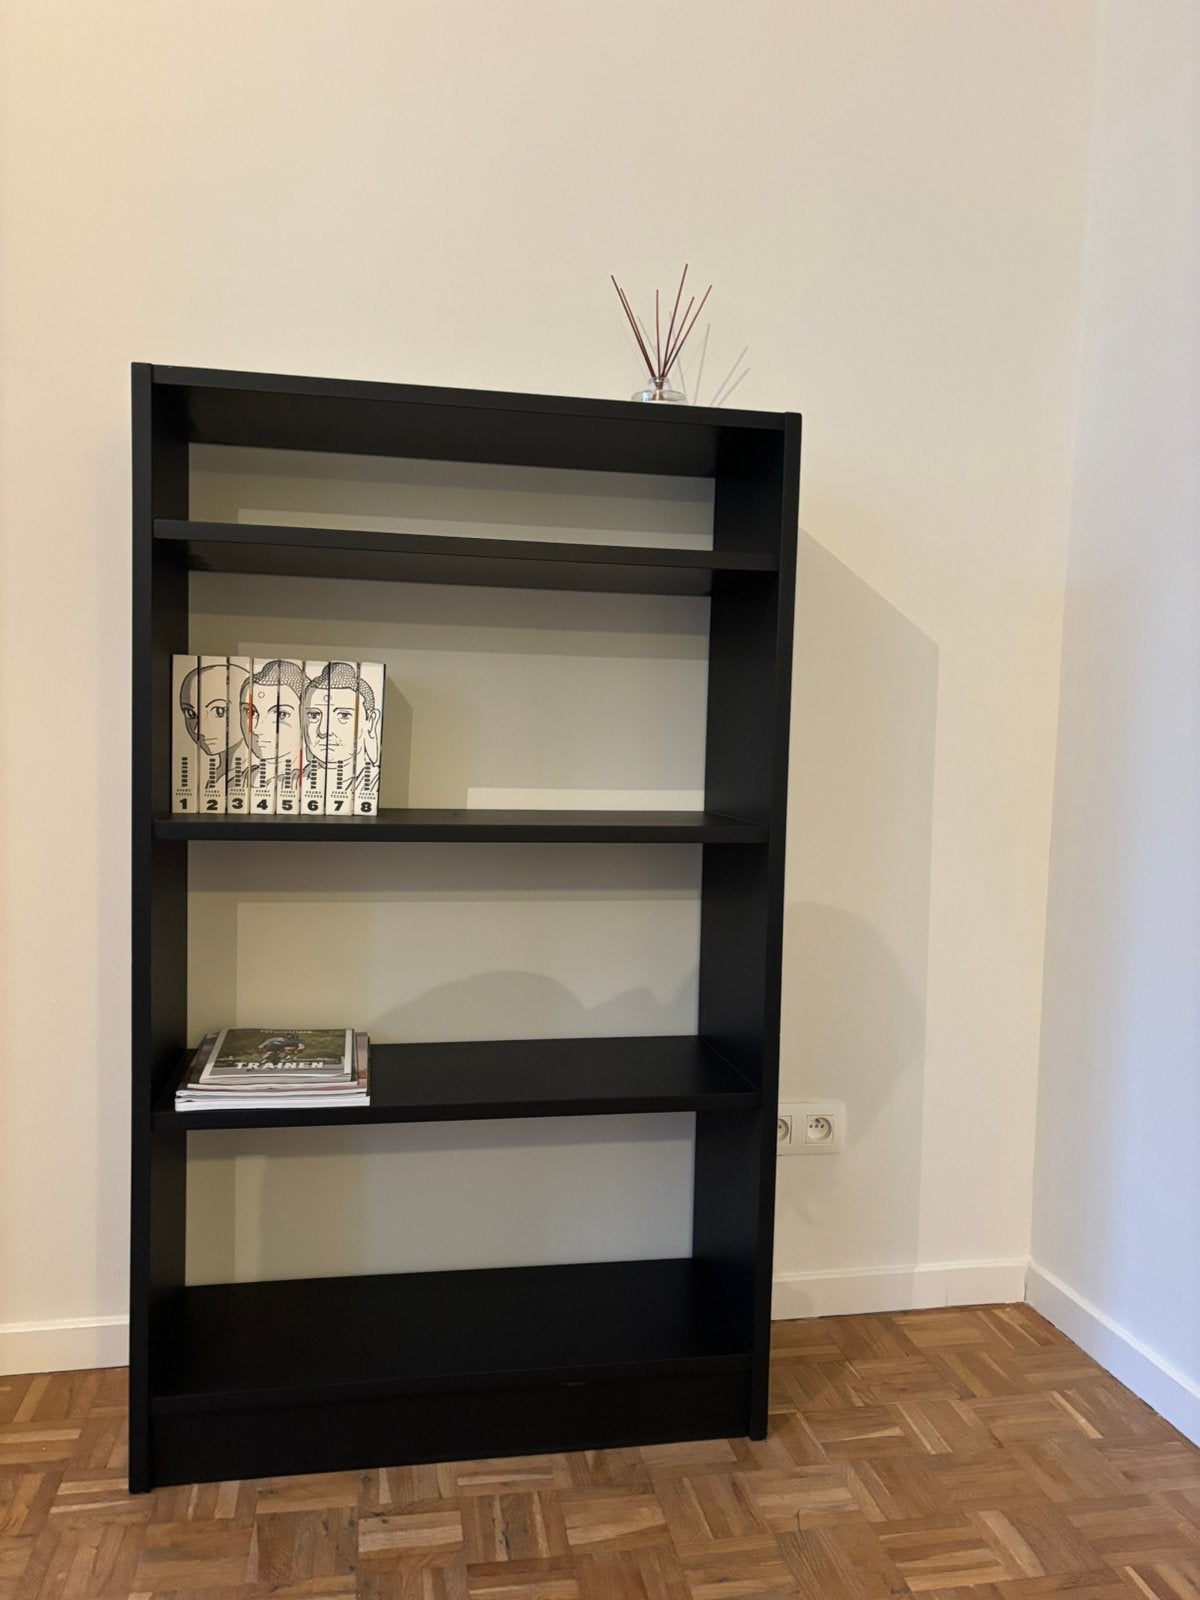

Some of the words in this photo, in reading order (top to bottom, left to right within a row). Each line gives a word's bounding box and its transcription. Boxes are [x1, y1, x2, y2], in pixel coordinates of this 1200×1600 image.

[180, 799, 187, 809] 1
[207, 800, 218, 810] 2
[232, 798, 243, 809] 3
[257, 799, 268, 809] 4
[282, 800, 293, 811] 5
[308, 800, 319, 811] 6
[334, 801, 344, 811] 7
[361, 802, 372, 812] 8
